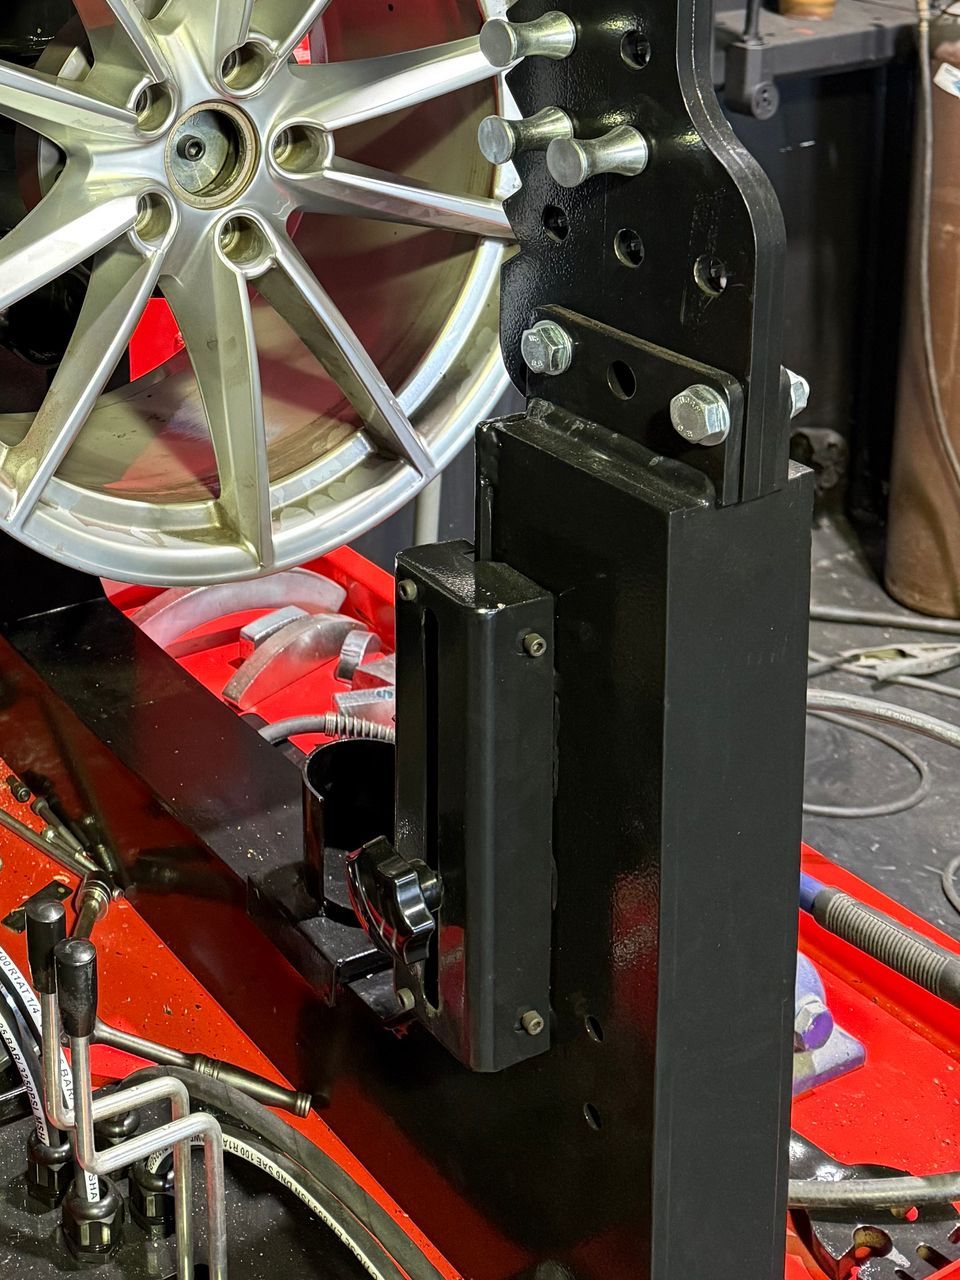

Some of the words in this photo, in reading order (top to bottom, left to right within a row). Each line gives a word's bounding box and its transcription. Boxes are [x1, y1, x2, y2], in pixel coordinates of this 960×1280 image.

[7, 965, 31, 995] R1AT
[88, 1172, 98, 1201] SHA
[222, 1137, 239, 1153] R1A
[240, 1147, 254, 1161] 100
[256, 1156, 274, 1176] SAE
